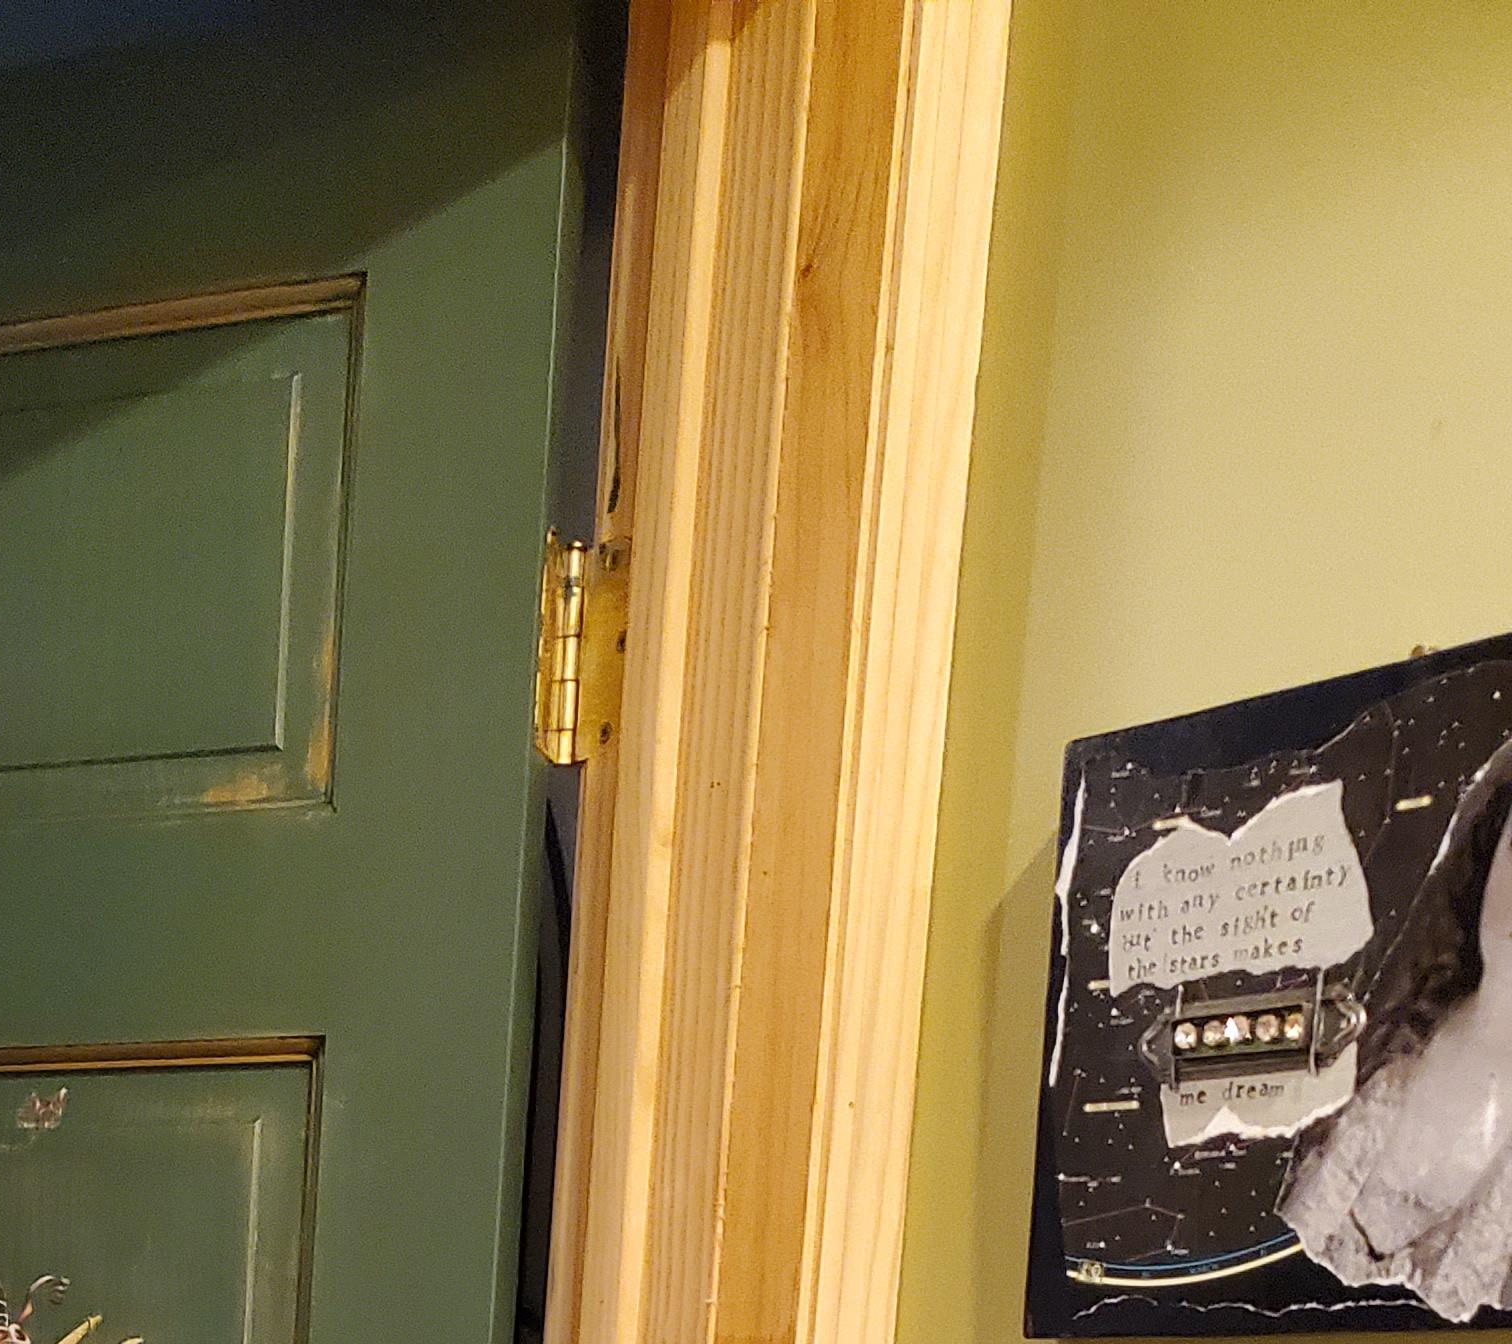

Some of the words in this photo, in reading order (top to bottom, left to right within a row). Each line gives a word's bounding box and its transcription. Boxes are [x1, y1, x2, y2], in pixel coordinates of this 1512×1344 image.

[1230, 834, 1325, 870] nothing
[1120, 902, 1168, 922] with
[1180, 894, 1219, 913] any
[1235, 865, 1348, 901] certainty
[1172, 925, 1204, 946] the
[1220, 907, 1278, 937] sight
[1291, 901, 1316, 923] of
[1128, 957, 1157, 980] the
[1169, 953, 1220, 974] stars
[1233, 937, 1304, 960] makes
[1180, 1090, 1207, 1106] me
[1222, 1081, 1285, 1101] dream
